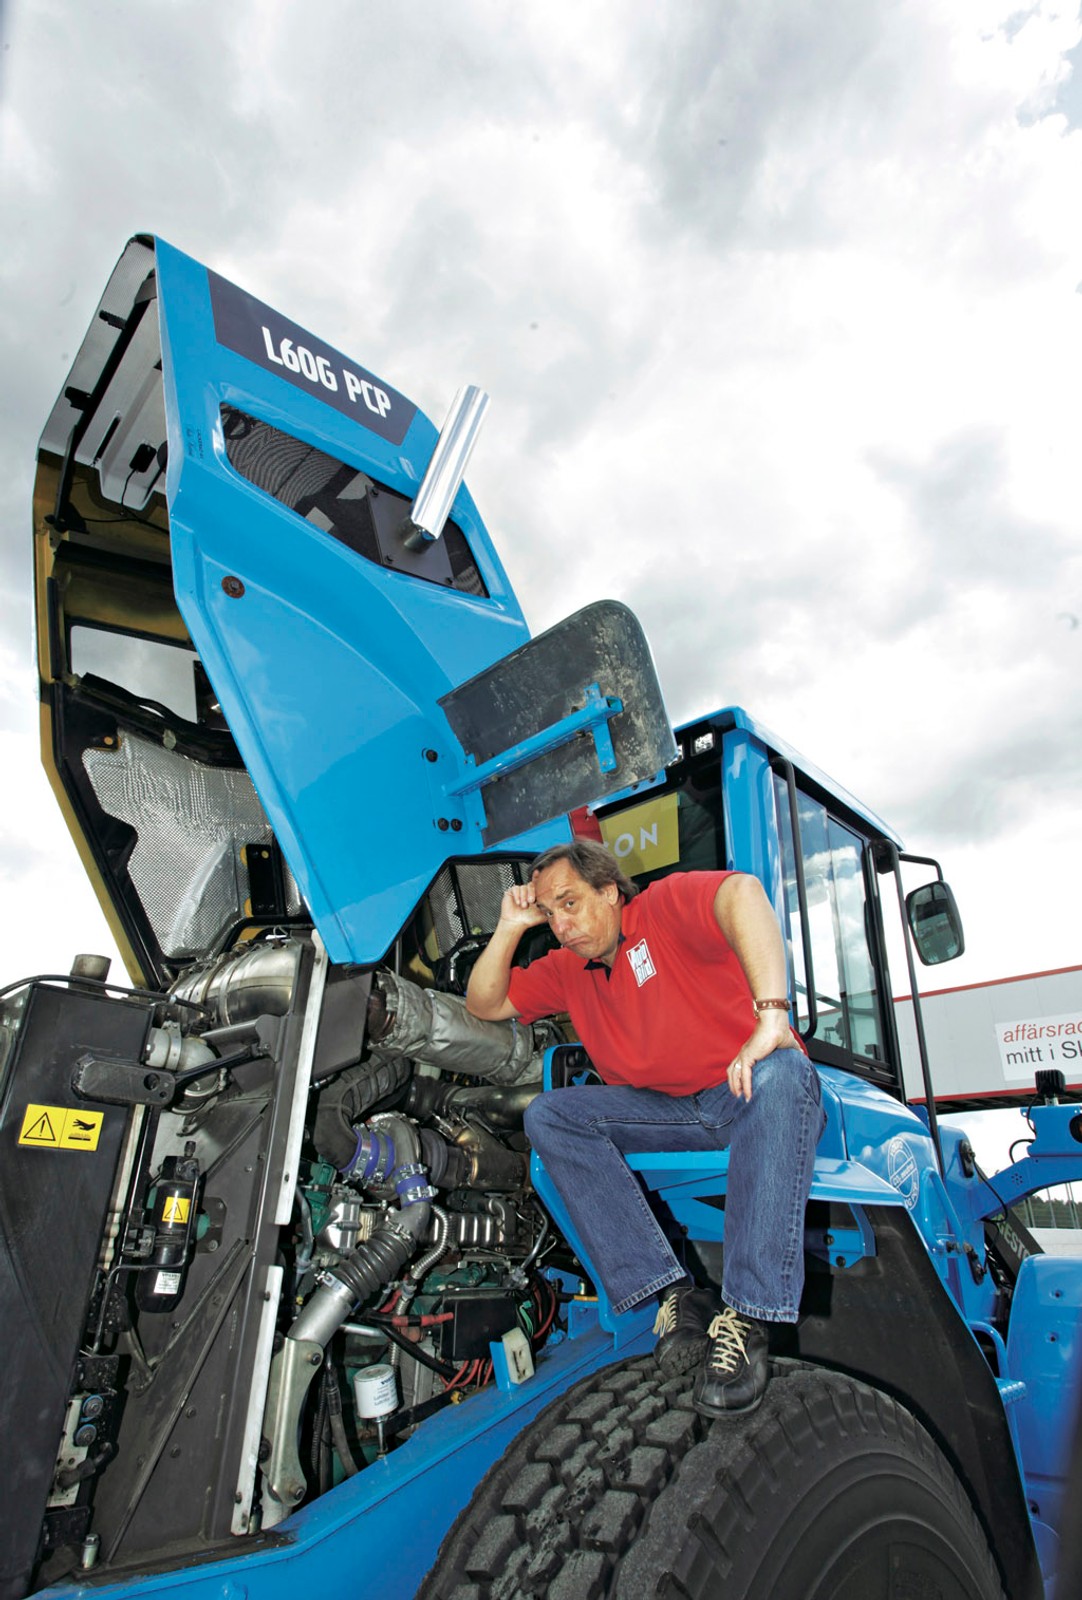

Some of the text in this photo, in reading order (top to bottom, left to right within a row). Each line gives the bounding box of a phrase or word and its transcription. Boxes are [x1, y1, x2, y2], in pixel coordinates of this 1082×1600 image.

[261, 326, 392, 419] L60G PCP
[603, 822, 658, 858] ON
[1005, 1046, 1044, 1065] mitt
[1048, 1043, 1055, 1060] i
